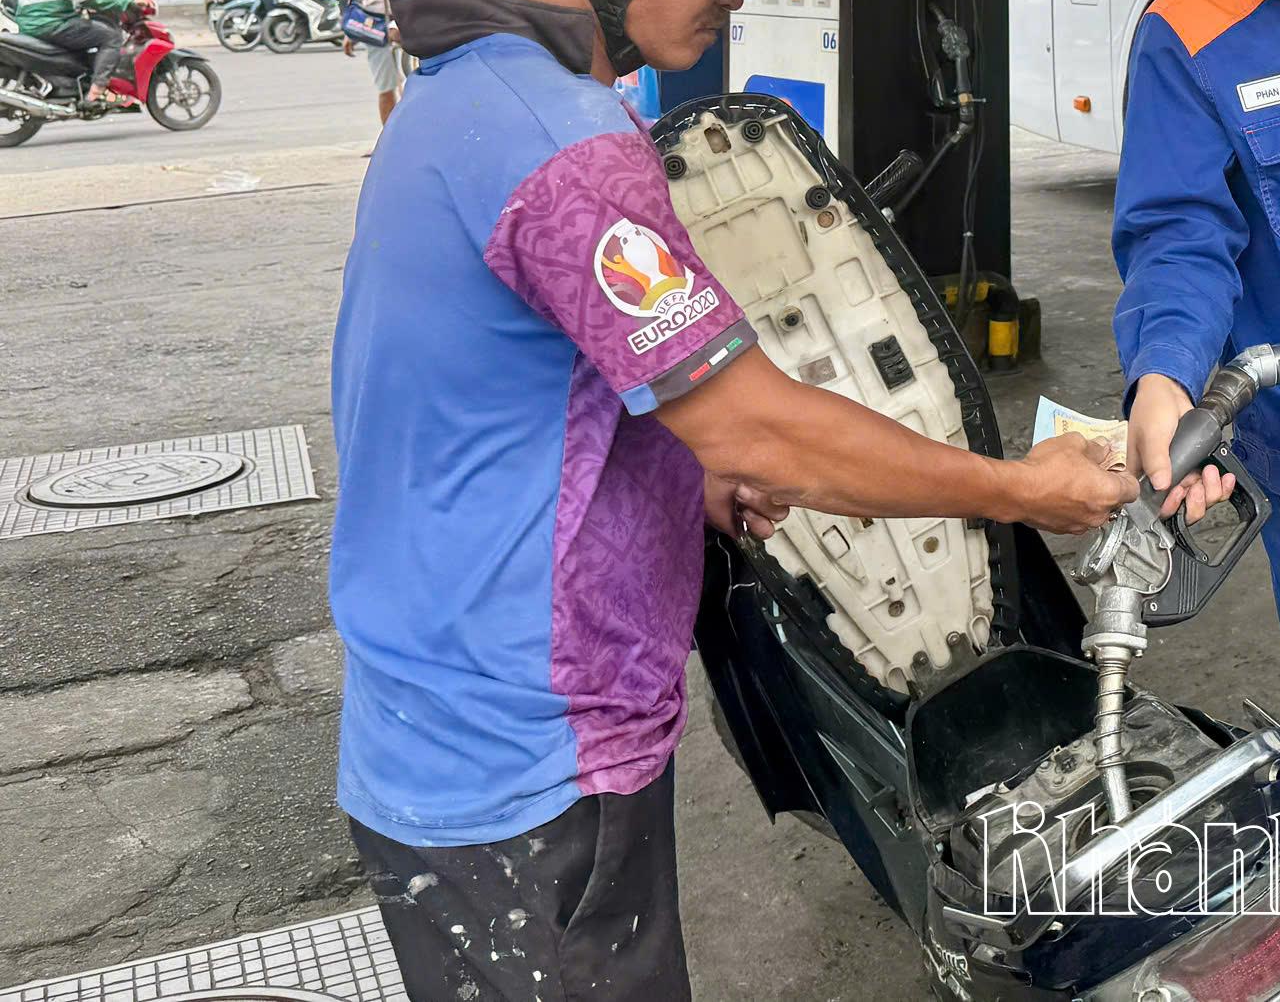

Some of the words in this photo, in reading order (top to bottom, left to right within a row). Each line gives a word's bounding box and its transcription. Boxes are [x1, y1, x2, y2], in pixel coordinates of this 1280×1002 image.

[732, 25, 744, 41] 07
[823, 32, 837, 50] 06
[1256, 88, 1280, 100] PHAN
[658, 295, 684, 315] UEFA
